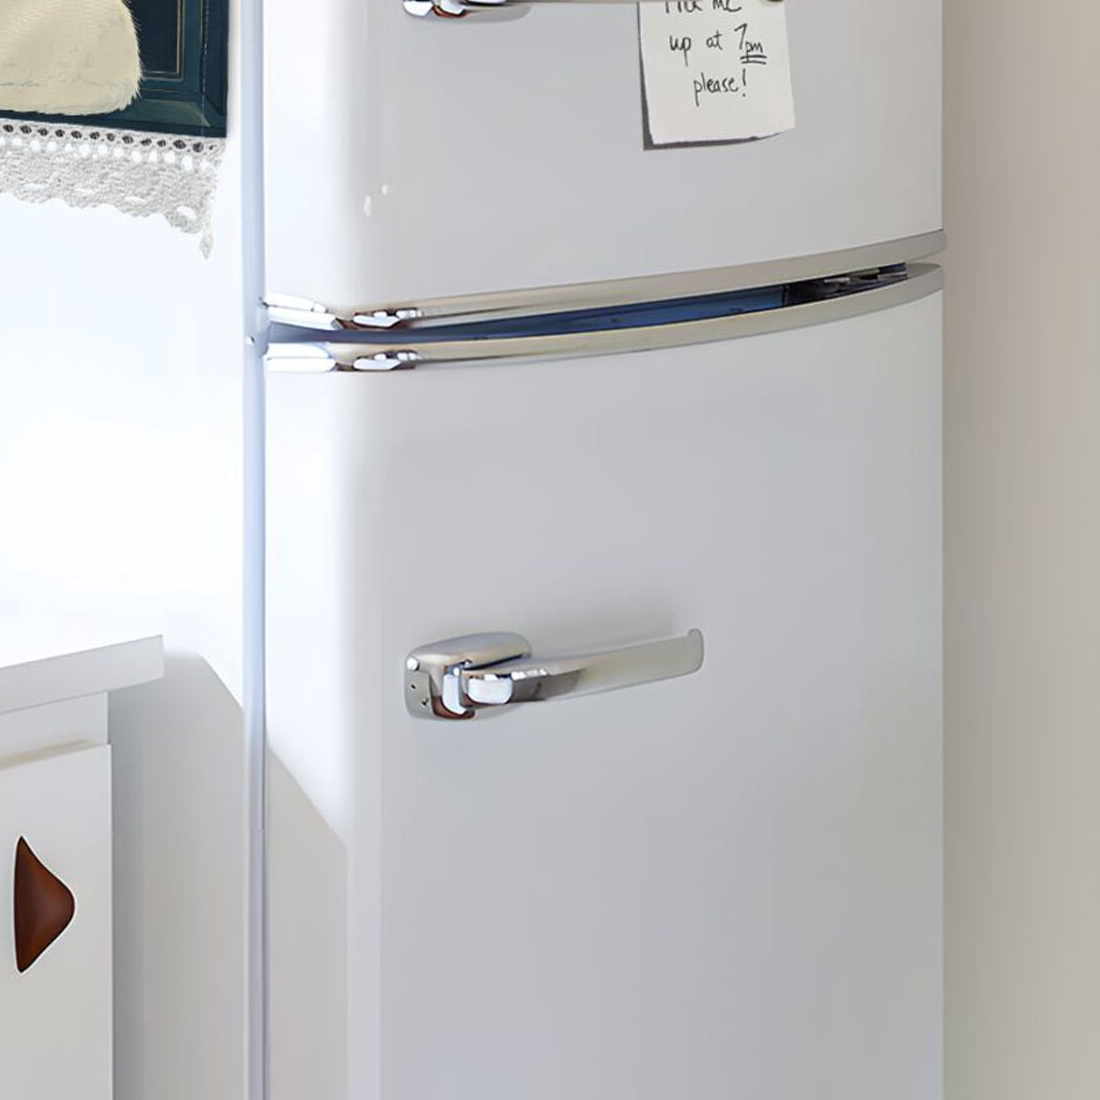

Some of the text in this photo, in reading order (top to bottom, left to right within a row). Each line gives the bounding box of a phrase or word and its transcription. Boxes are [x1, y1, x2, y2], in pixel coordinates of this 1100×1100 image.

[669, 35, 692, 66] up
[706, 29, 723, 51] at
[693, 68, 747, 107] please!
